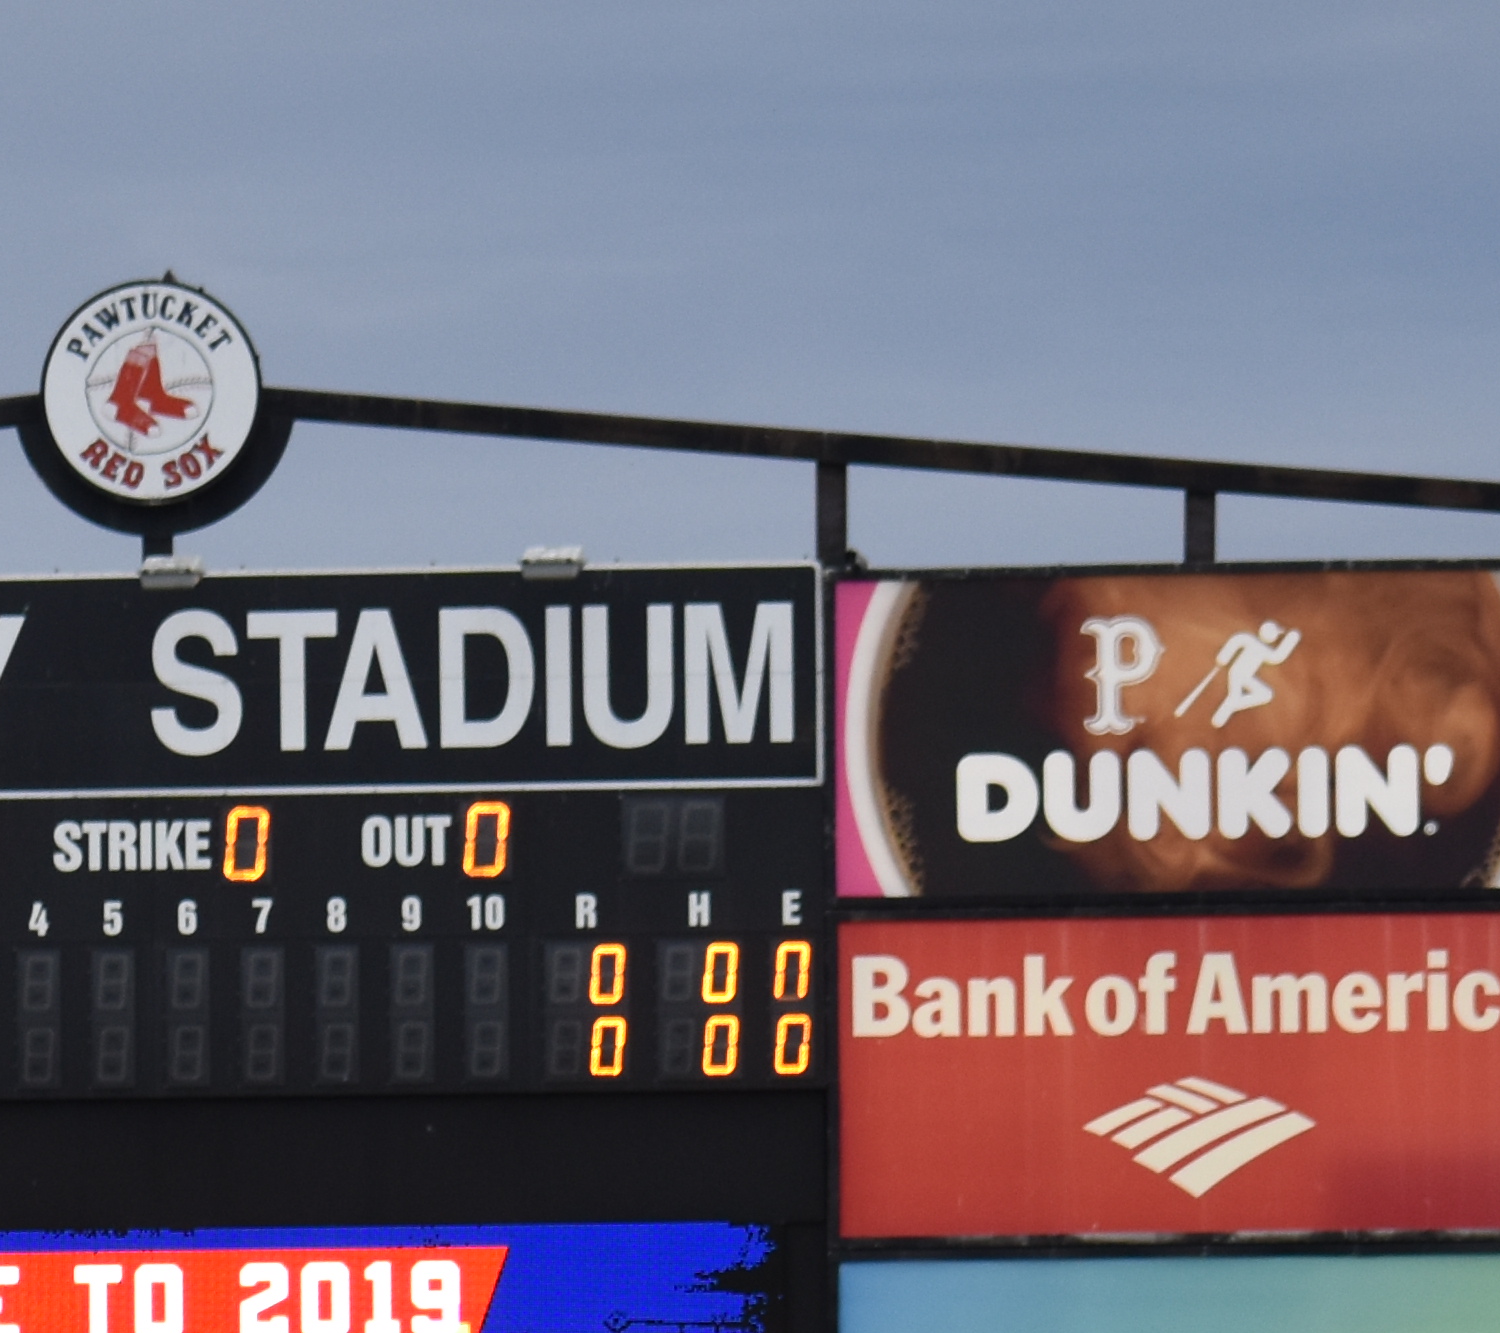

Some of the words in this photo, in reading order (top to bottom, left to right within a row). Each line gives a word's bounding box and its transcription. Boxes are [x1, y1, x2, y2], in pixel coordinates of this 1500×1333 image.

[66, 293, 233, 361] PAWTUCKET
[80, 438, 145, 489] RED
[161, 433, 224, 489] SOX
[150, 602, 794, 756] STADIUM
[955, 744, 1454, 843] DUNKIN'
[53, 820, 212, 872] STRIKE
[223, 806, 270, 881] 0
[361, 815, 452, 867] OUT
[462, 802, 511, 878] 0
[28, 903, 48, 936] 4
[103, 902, 122, 936] 5
[178, 899, 197, 935] 6
[252, 899, 273, 934] 7
[327, 898, 347, 932] 8
[402, 897, 422, 931] 9
[467, 896, 505, 930] 10
[576, 893, 597, 928] R
[688, 892, 710, 926] H
[782, 891, 801, 926] E
[589, 944, 626, 1004] 0
[702, 942, 739, 1003] 0
[852, 953, 1074, 1038] Bank
[1085, 951, 1176, 1035] of
[590, 1016, 626, 1076] 0
[703, 1015, 739, 1076] 0
[774, 1013, 810, 1075] 0
